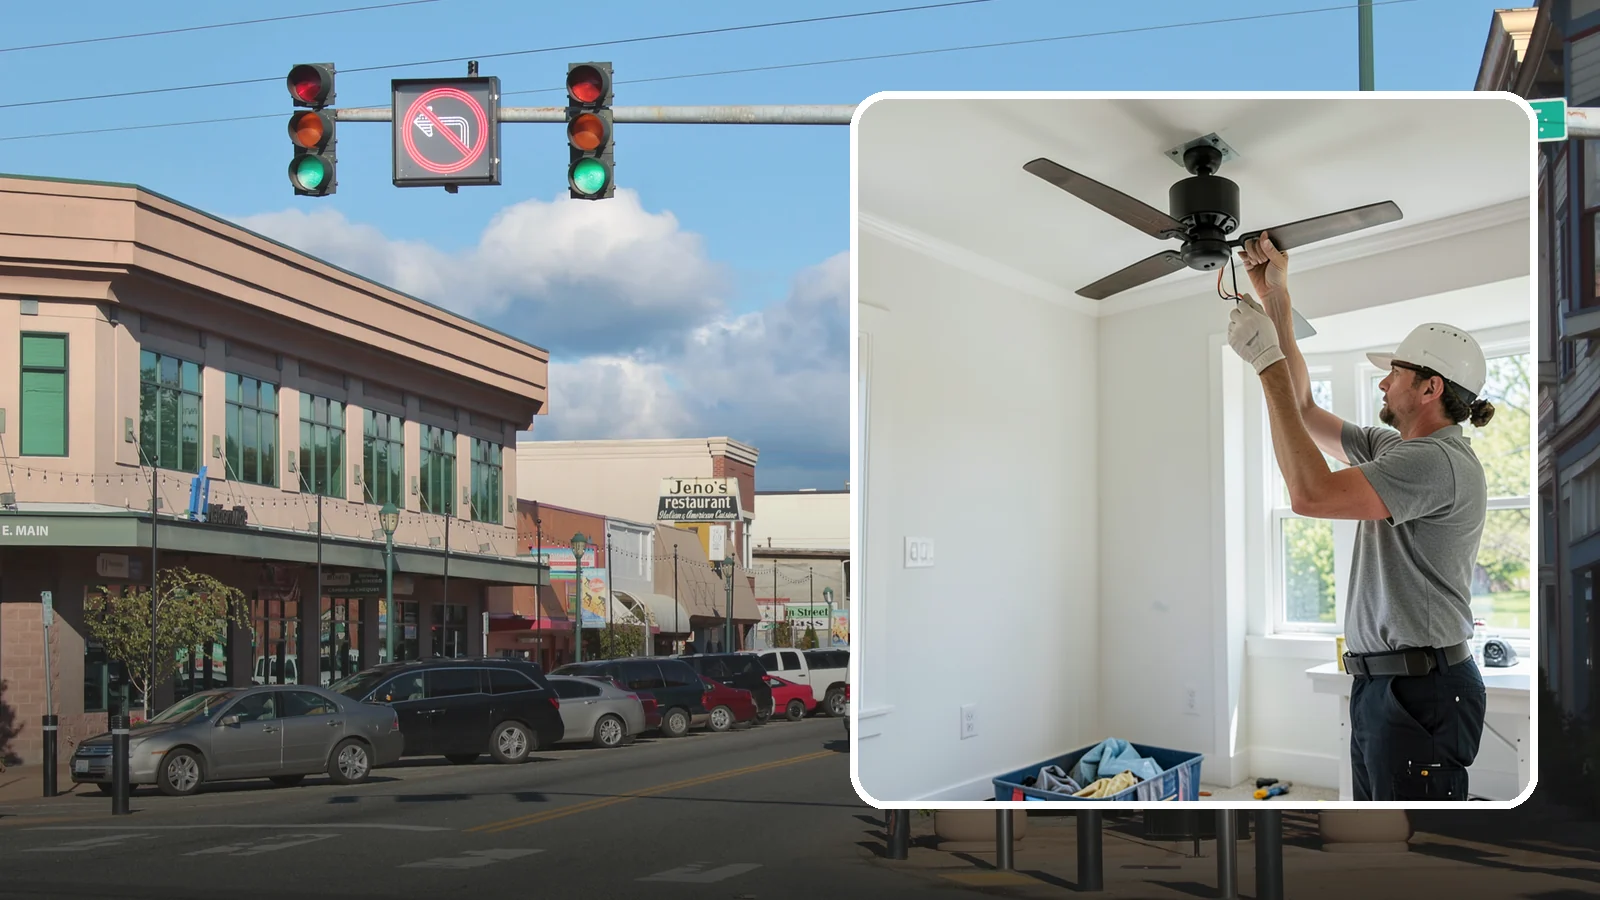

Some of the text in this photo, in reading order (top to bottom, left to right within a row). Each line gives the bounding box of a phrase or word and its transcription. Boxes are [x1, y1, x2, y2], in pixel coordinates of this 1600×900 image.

[669, 480, 728, 495] Jeno's
[665, 496, 731, 509] restaurant
[659, 510, 682, 520] Italian
[686, 510, 714, 520] American
[715, 510, 738, 519] Cuisine
[2, 525, 49, 536] E. MAIN
[786, 607, 829, 617] in Street
[791, 619, 824, 627] lass
